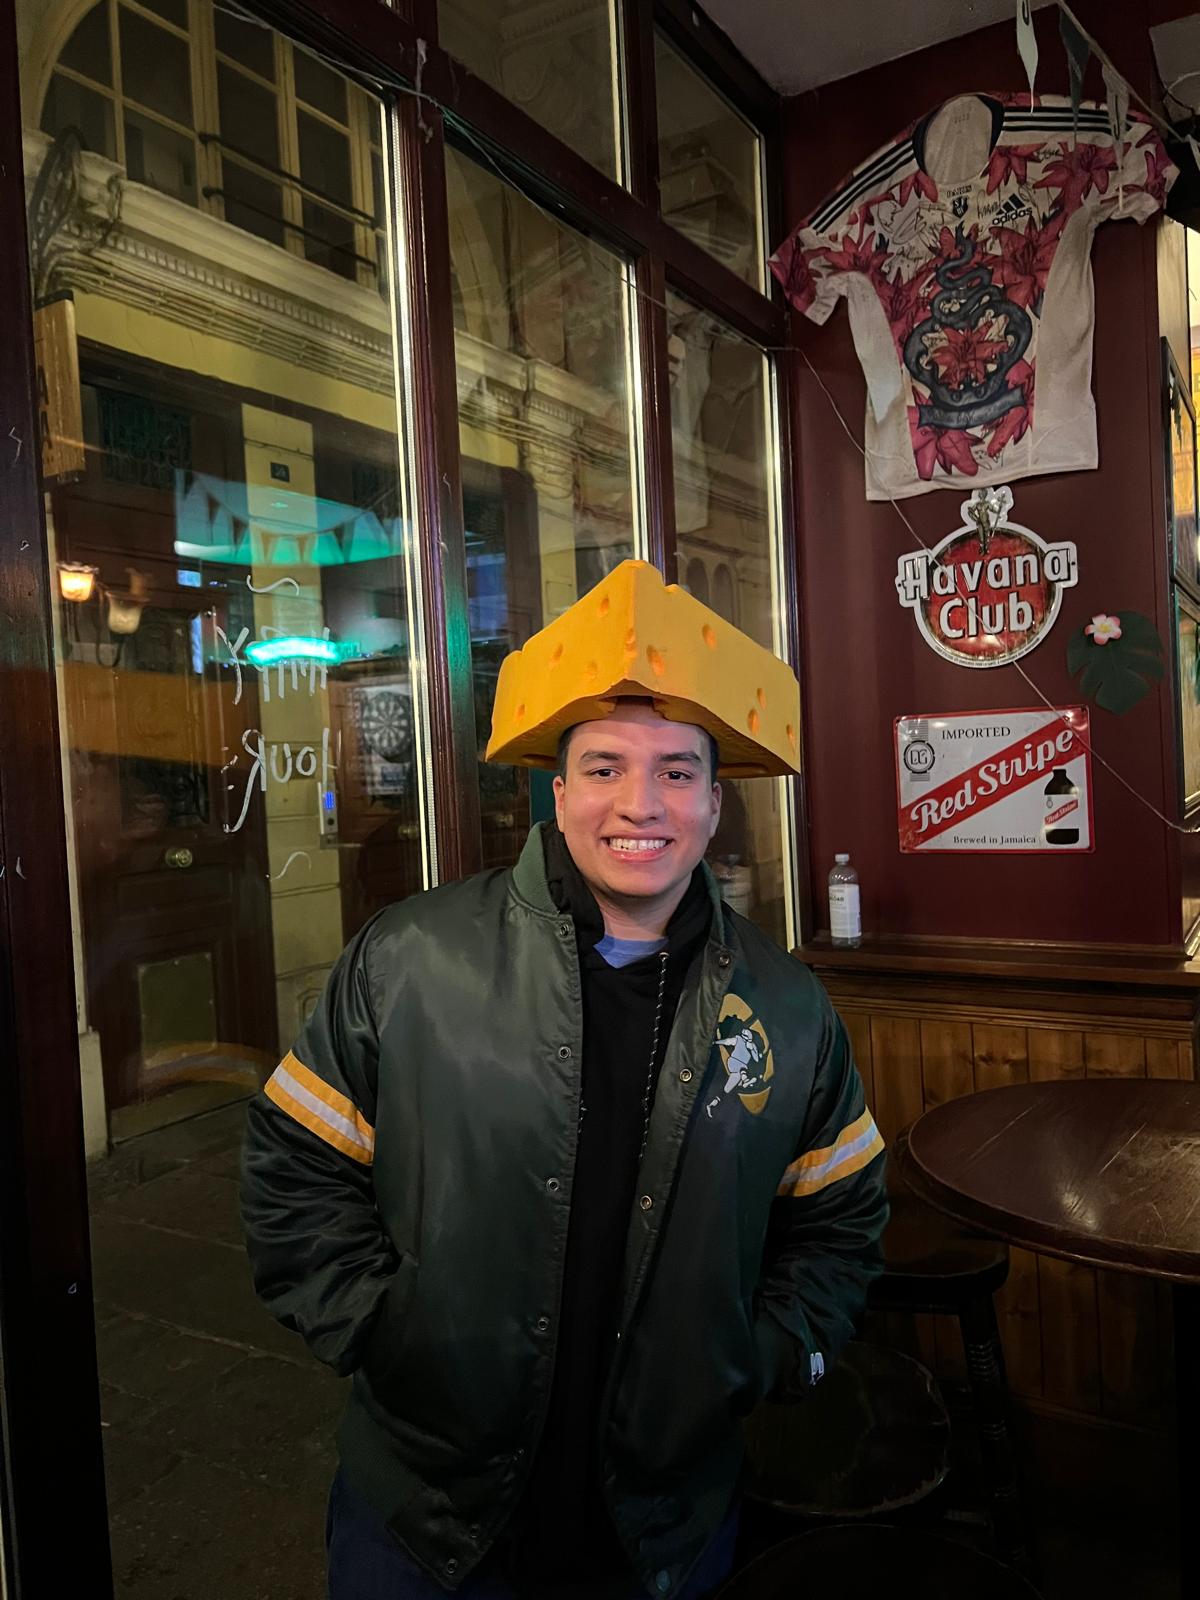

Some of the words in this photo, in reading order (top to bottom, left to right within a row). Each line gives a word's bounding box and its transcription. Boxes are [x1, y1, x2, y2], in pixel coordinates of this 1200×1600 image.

[992, 207, 1033, 225] adidas
[901, 548, 1071, 600] Havana
[939, 592, 1034, 638] Club
[942, 727, 1011, 740] IMPORTED
[910, 779, 977, 833] Red
[976, 728, 1074, 796] Stripe
[953, 835, 987, 844] Brewed
[989, 836, 998, 844] in
[999, 835, 1037, 845] Jamaica
